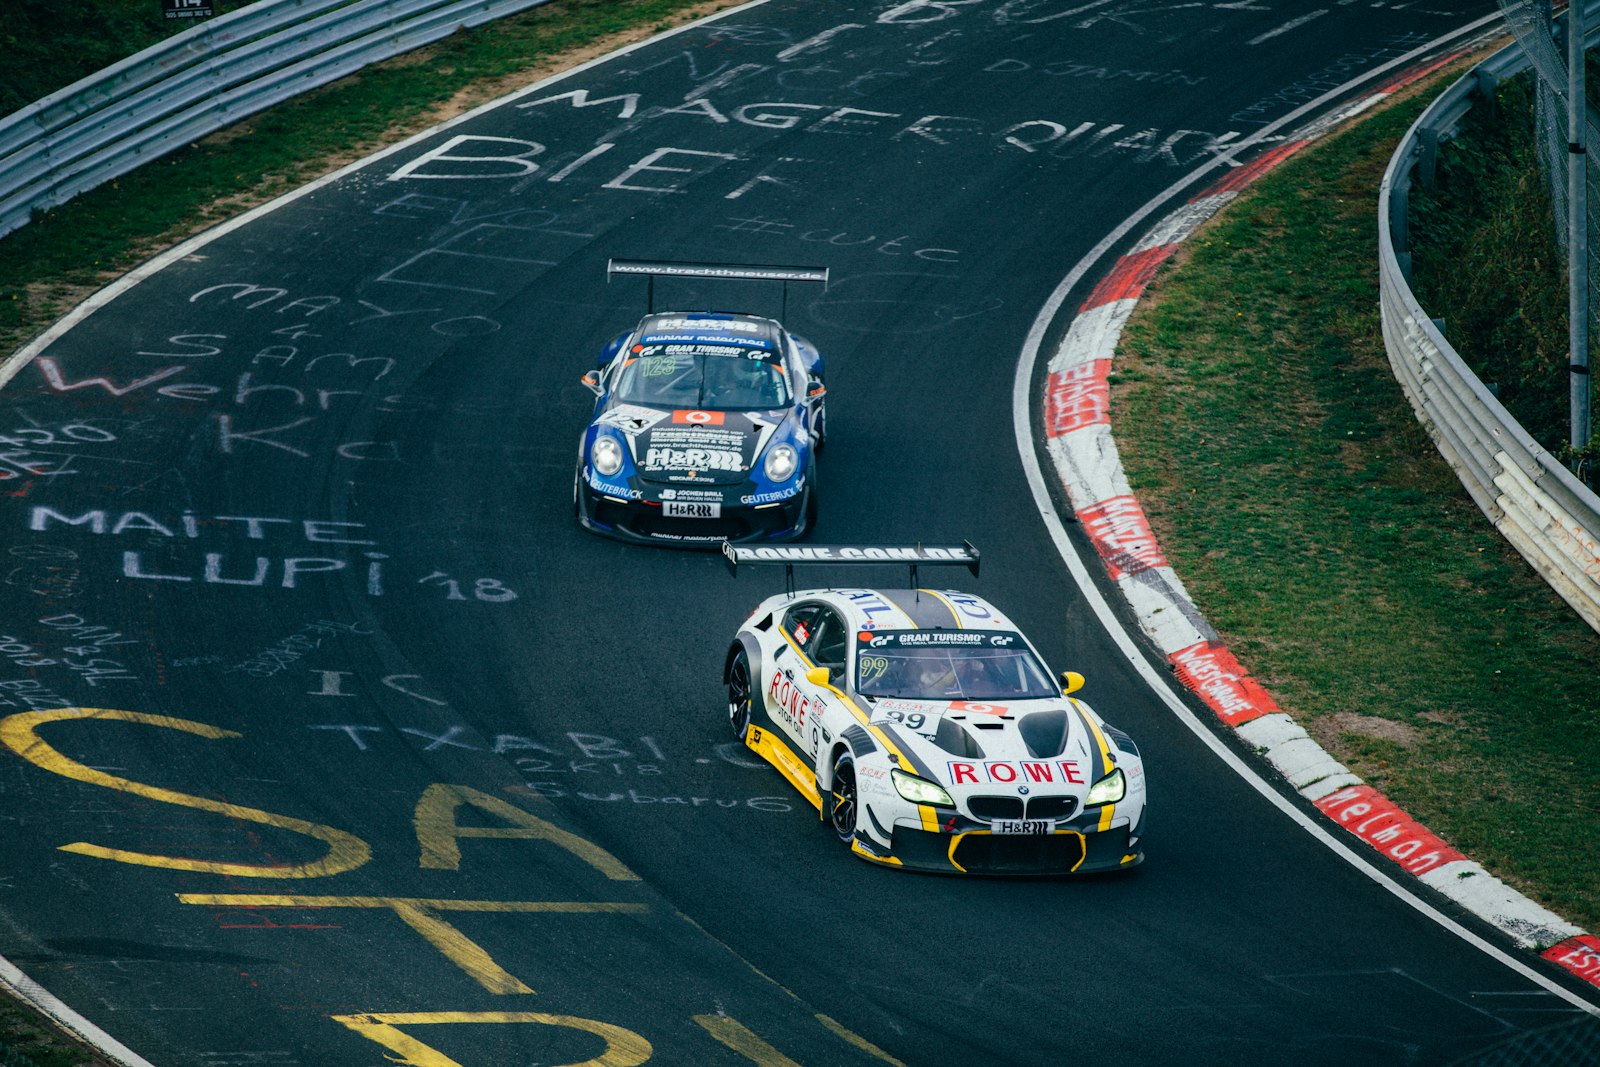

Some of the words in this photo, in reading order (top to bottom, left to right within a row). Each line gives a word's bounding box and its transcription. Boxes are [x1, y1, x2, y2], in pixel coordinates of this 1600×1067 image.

[665, 344, 694, 353] GRAN
[642, 356, 677, 377] 123
[898, 633, 931, 643] GRAN
[859, 656, 889, 678] 99
[886, 710, 926, 730] 99
[947, 760, 1086, 785] ROWE
